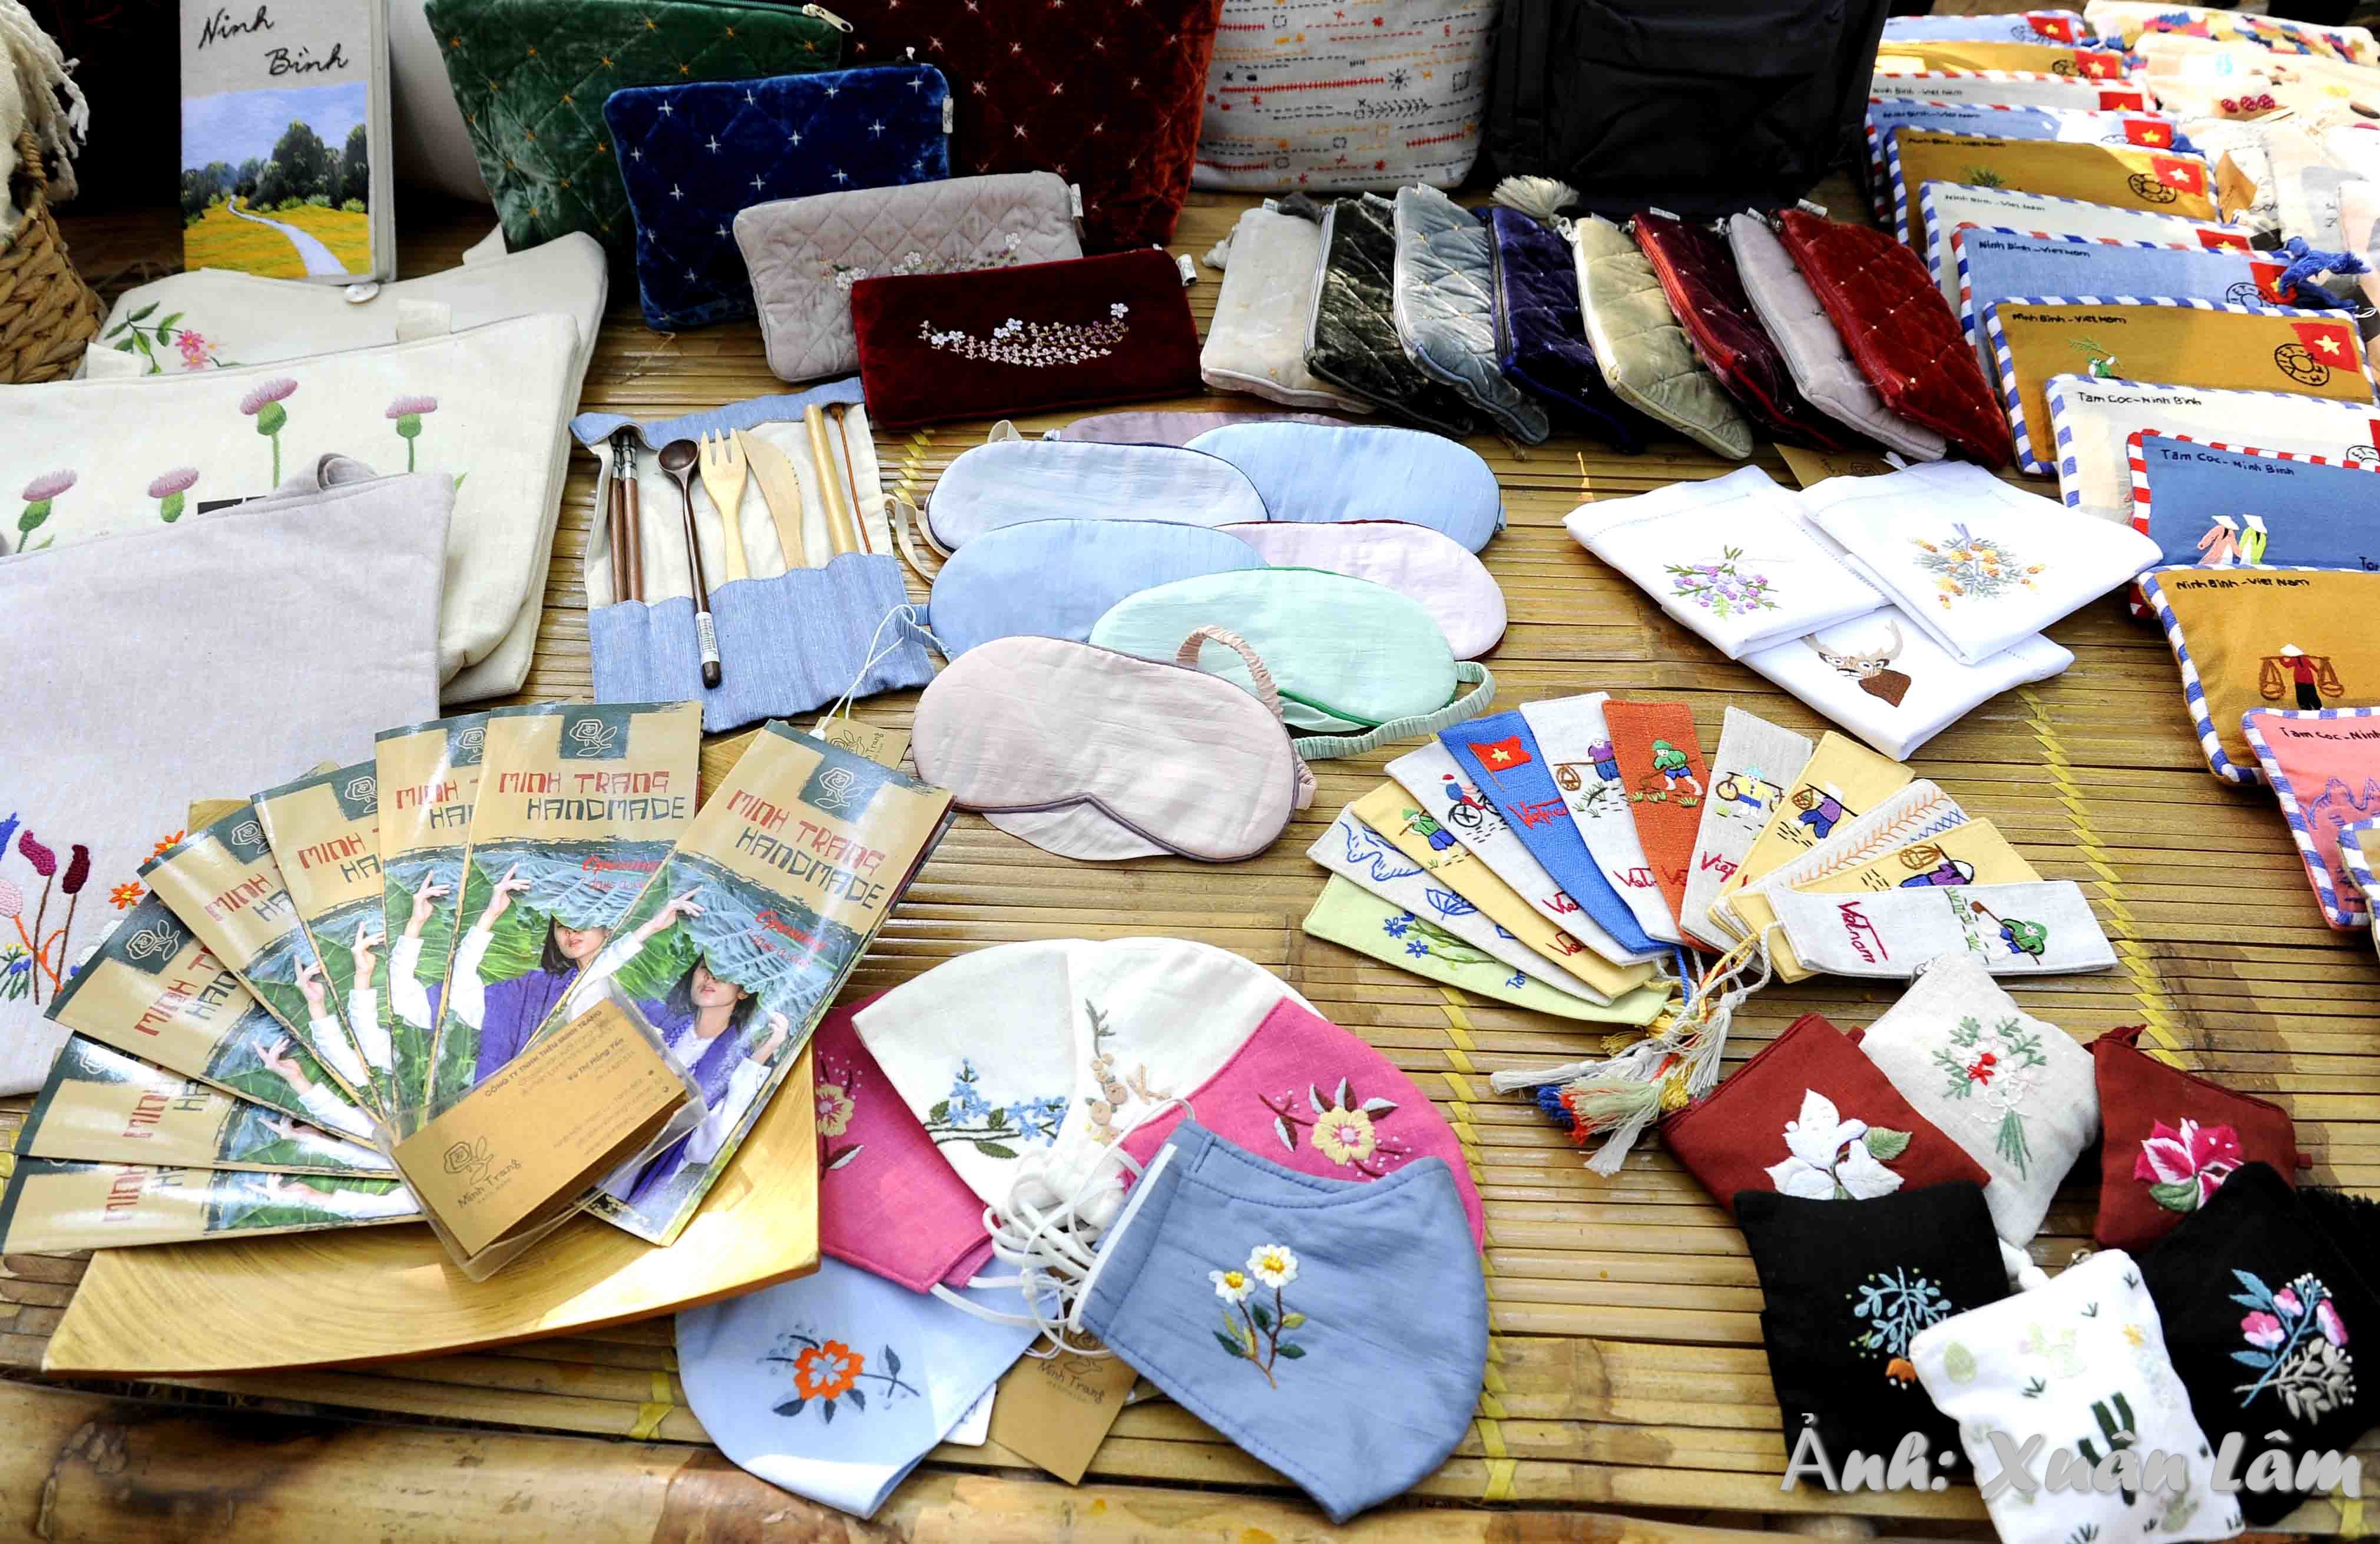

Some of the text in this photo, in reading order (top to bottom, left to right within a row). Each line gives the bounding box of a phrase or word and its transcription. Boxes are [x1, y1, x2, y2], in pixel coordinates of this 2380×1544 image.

[198, 5, 274, 49] Ninh
[2077, 391, 2106, 403] Tam
[2160, 449, 2192, 461] Tam
[2279, 727, 2315, 738] Tam
[499, 771, 670, 794] MINH TRANG
[527, 797, 686, 821] HANDMADE
[727, 790, 886, 876] MINH TRANG
[298, 832, 366, 869] MINH
[734, 827, 886, 910] HANDMADE
[204, 873, 274, 923] MINH
